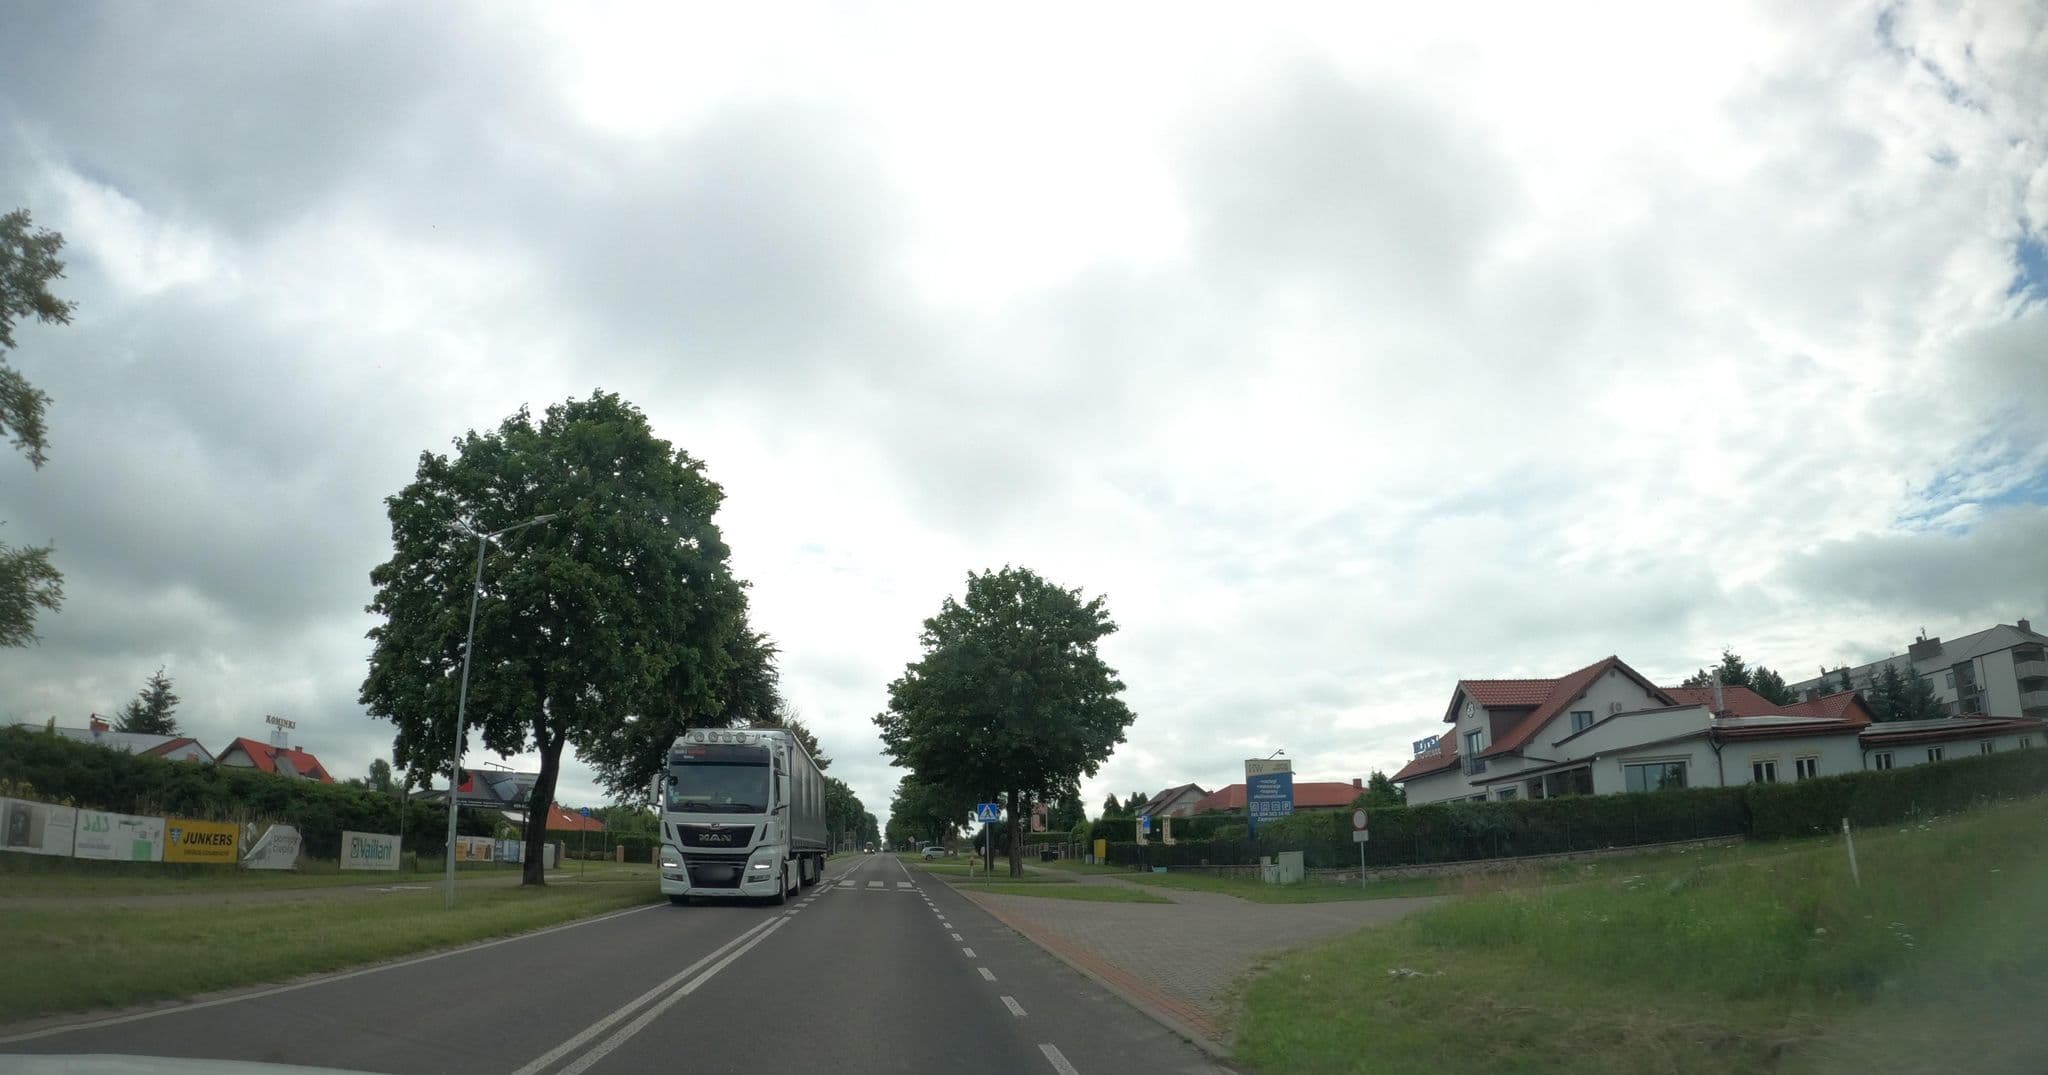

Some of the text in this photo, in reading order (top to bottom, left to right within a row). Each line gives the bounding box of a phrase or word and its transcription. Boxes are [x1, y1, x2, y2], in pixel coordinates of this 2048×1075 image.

[183, 831, 233, 846] JUNKERS
[699, 833, 732, 841] MAN
[360, 838, 392, 860] Vaillant
